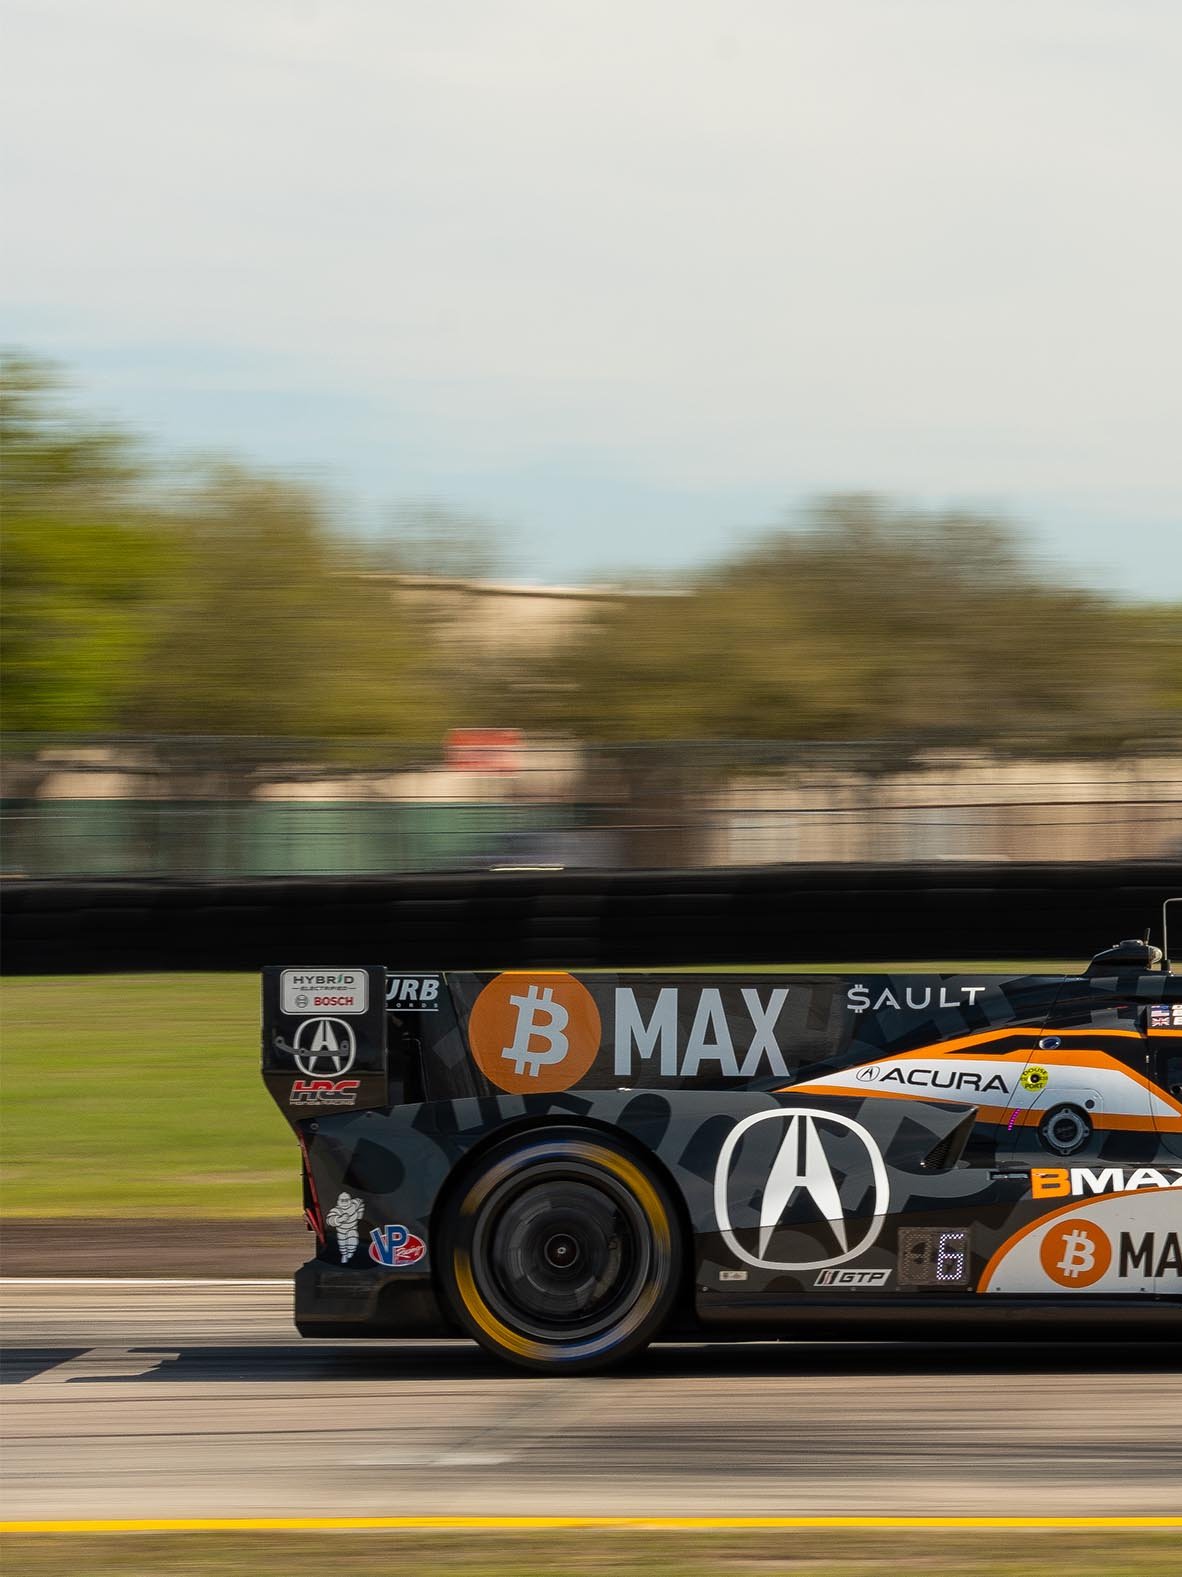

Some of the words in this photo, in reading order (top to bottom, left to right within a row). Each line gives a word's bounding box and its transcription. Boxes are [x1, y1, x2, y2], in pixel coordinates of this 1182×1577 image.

[293, 974, 354, 984] HYBRID
[385, 979, 440, 1001] URB
[314, 996, 353, 1006] BOSCH
[614, 988, 790, 1077] MAX
[289, 1080, 361, 1101] HRC
[879, 1067, 1010, 1094] ACURA
[370, 1225, 409, 1265] VP
[936, 1233, 964, 1281] 6
[839, 1272, 885, 1283] GTP
